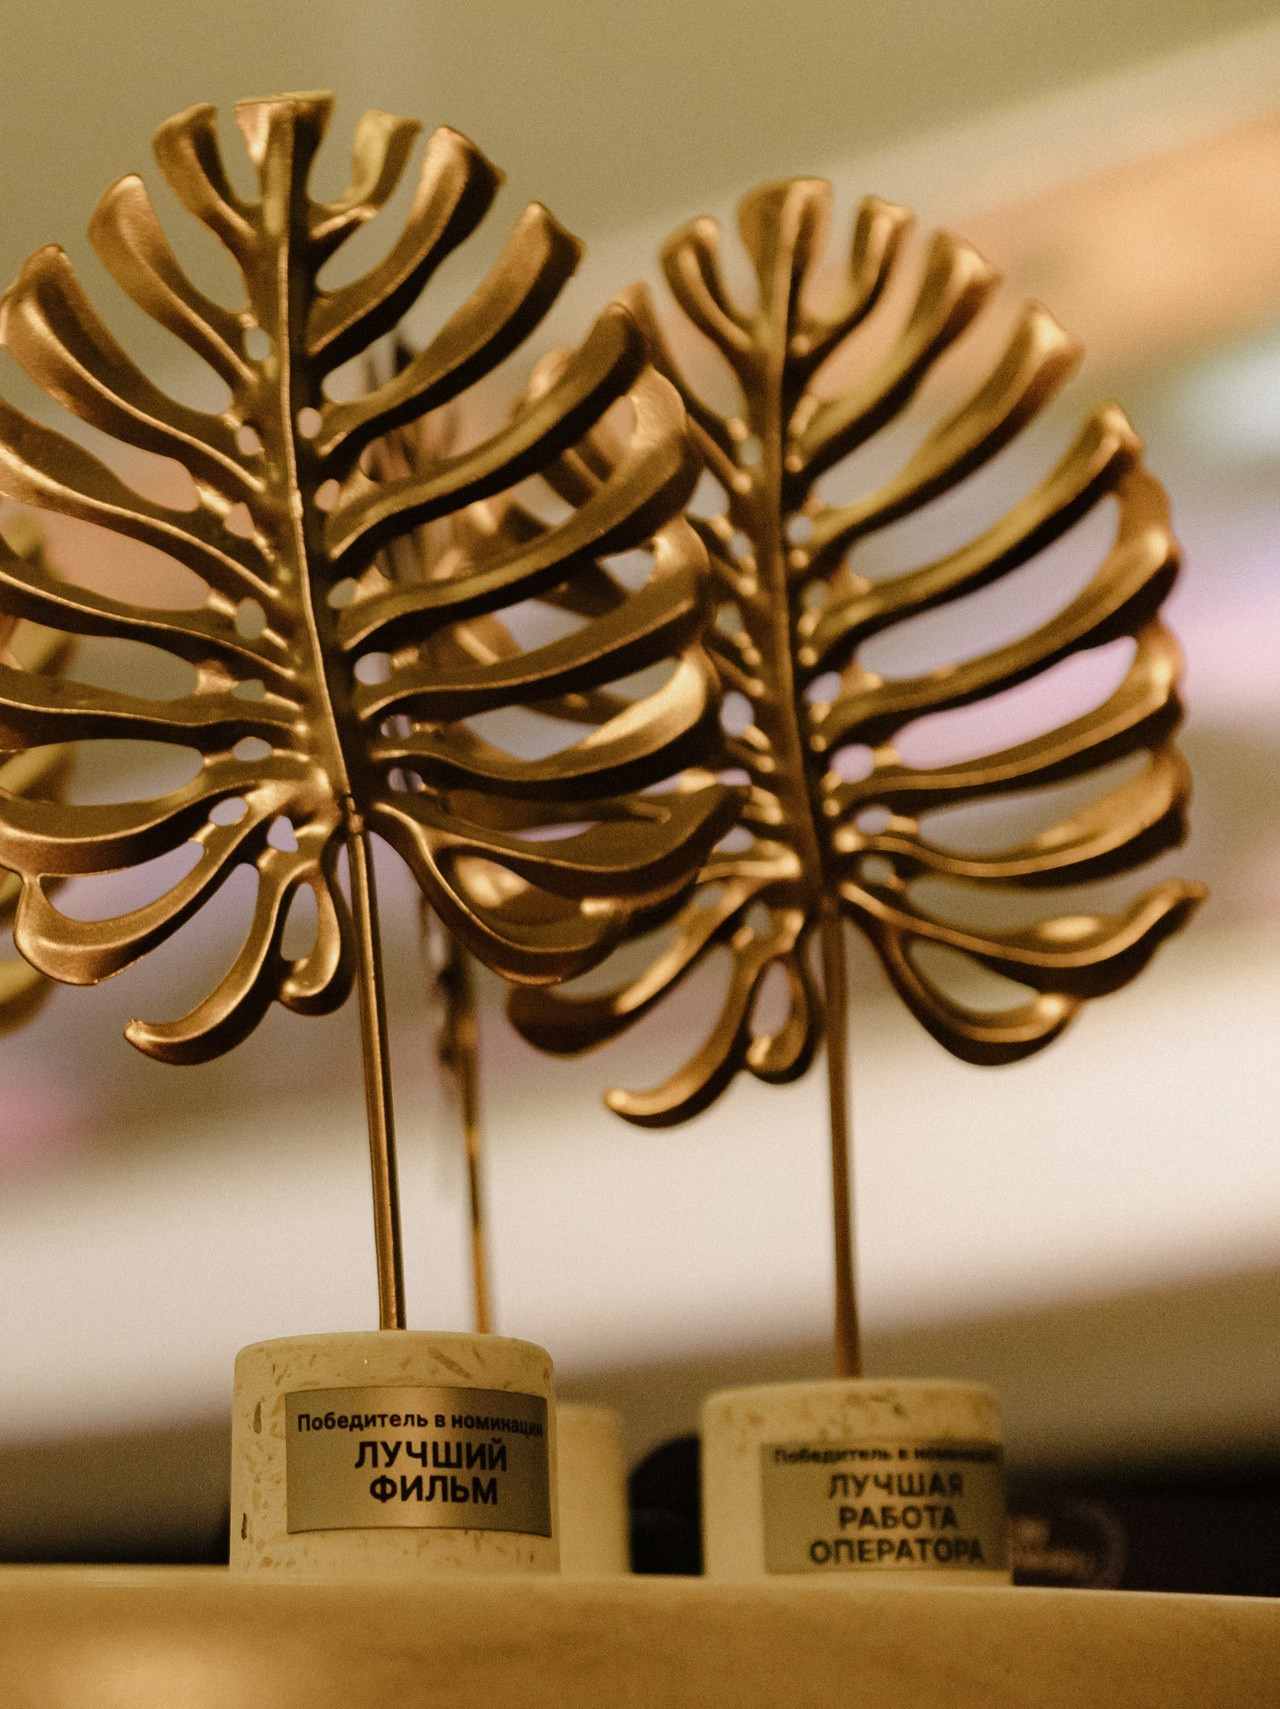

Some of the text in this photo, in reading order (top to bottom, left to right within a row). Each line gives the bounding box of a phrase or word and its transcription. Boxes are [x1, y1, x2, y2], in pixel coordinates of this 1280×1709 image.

[297, 1411, 428, 1433] Победитель
[434, 1414, 446, 1428] в
[355, 1438, 507, 1472] ЛУЧШИЙ
[370, 1475, 498, 1505] ФИЛЬМ
[829, 1473, 963, 1498] ЛУЧШАЯ
[839, 1505, 958, 1530] РАБОТА
[809, 1537, 984, 1564] ОПЕРАТОРА
